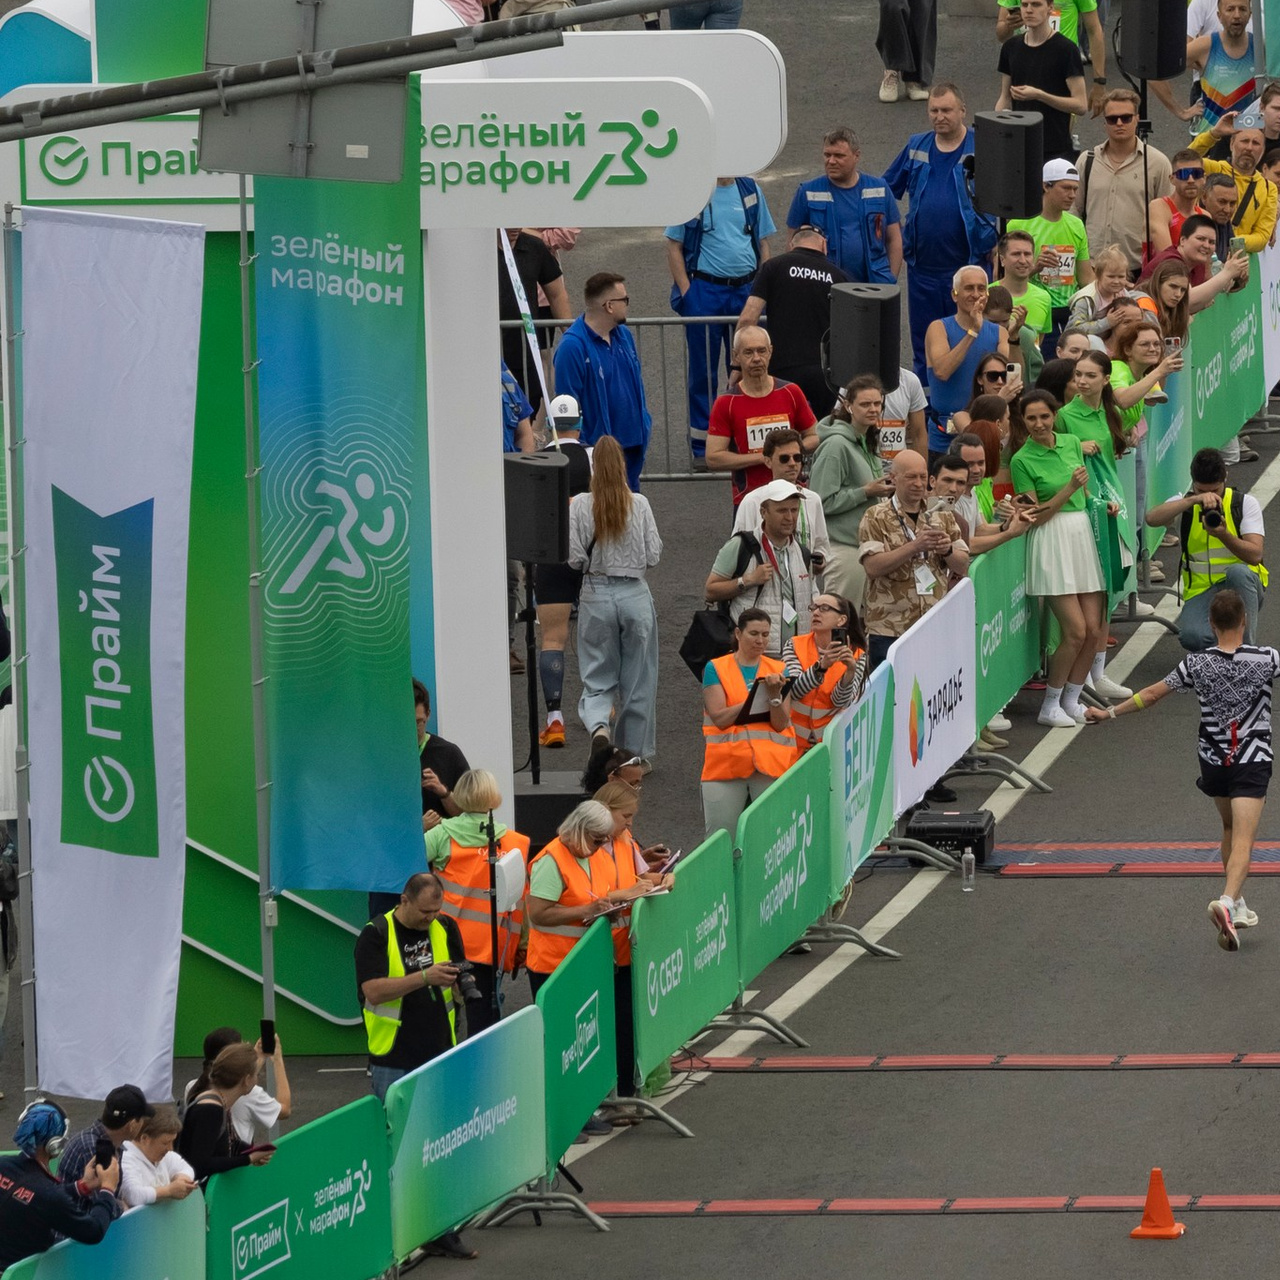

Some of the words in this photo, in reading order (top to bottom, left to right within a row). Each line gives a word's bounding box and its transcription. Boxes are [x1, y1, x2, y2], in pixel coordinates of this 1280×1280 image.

[101, 136, 204, 184] Пра
[420, 152, 571, 193] арафон
[270, 232, 405, 276] зелёный
[789, 266, 834, 284] ОХРАНА
[270, 262, 404, 307] марафон
[1204, 351, 1223, 399] СБЕР
[78, 543, 132, 741] Прайм
[926, 666, 964, 747] ЗАРЯДЬЕ
[764, 809, 798, 880] зелёный
[759, 866, 794, 927] марафон
[658, 947, 684, 997] СБЕР
[695, 901, 719, 944] зелёный
[693, 932, 718, 974] марафон
[422, 1095, 518, 1168] #создаваябудущее
[313, 1168, 353, 1209] зелёный
[249, 1221, 282, 1260] Прайм
[309, 1201, 350, 1236] марафон
